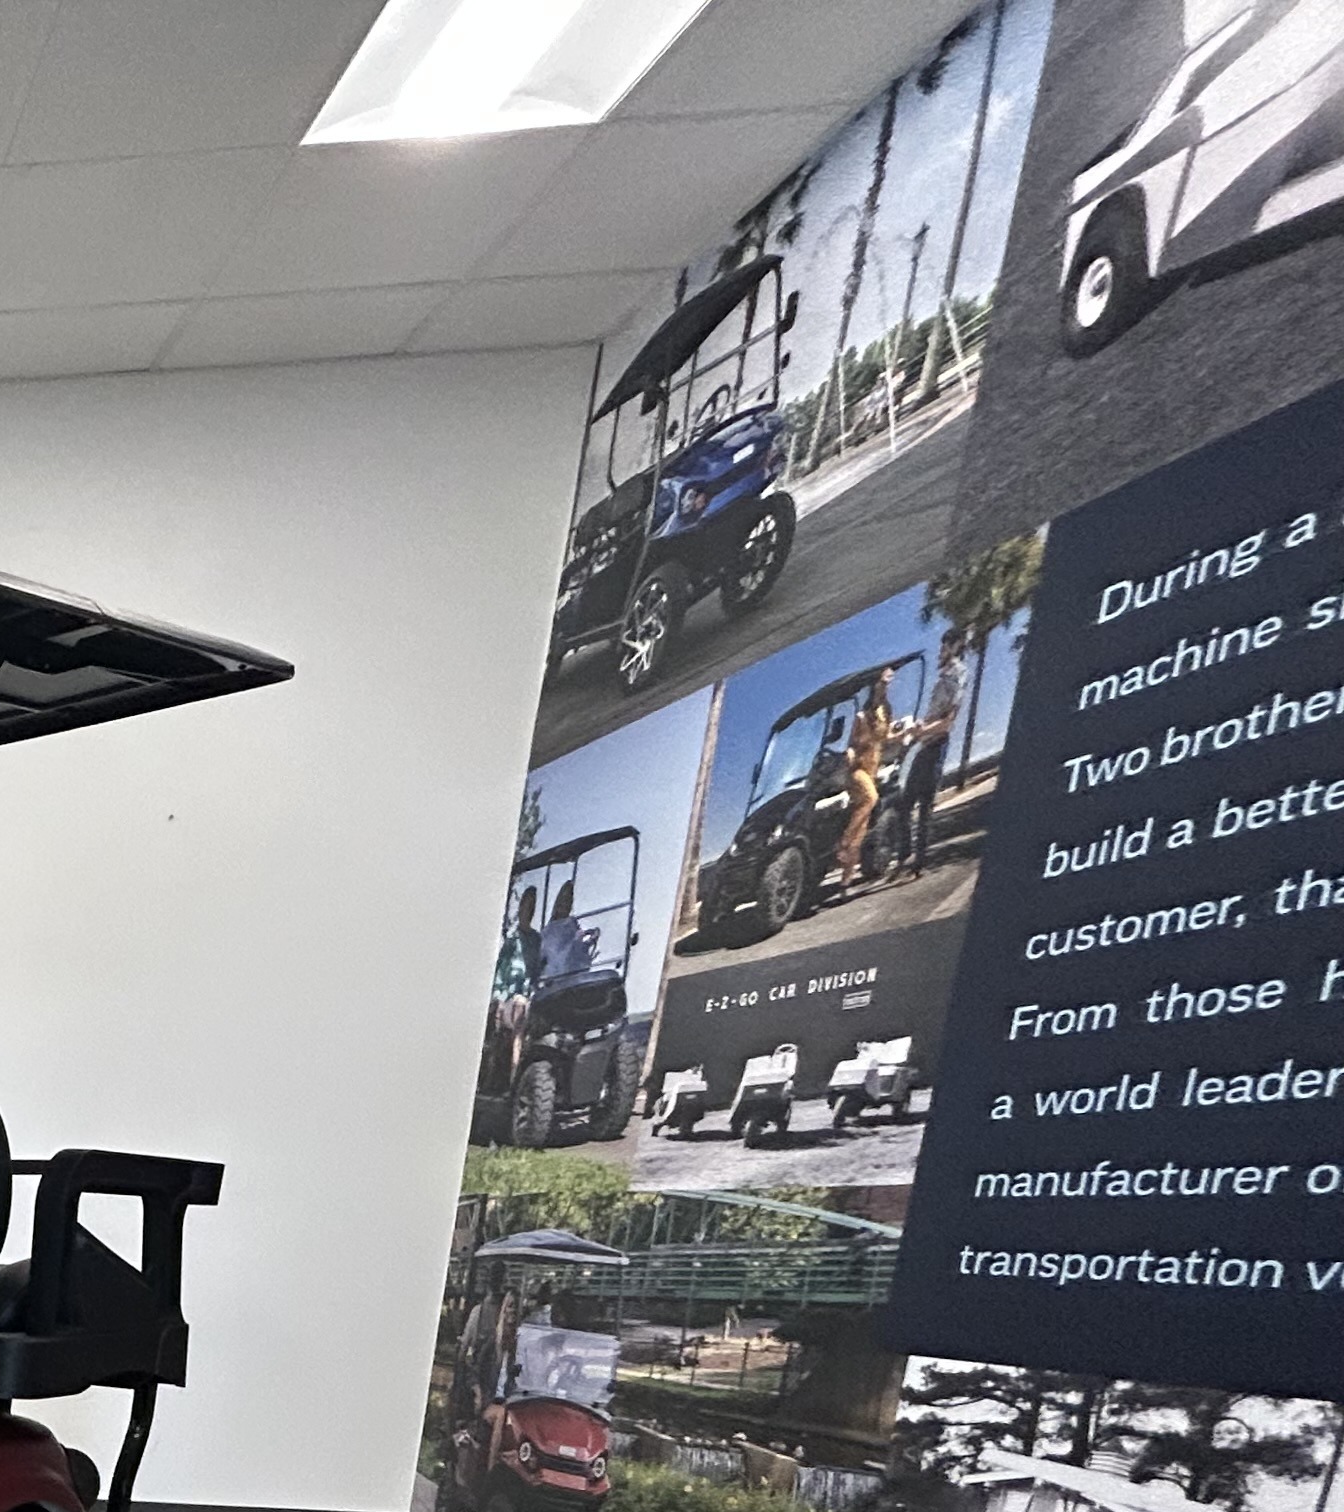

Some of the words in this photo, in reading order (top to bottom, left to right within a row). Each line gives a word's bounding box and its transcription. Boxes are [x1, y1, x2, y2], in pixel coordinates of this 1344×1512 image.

[1097, 528, 1267, 625] During
[1282, 512, 1317, 549] a
[1078, 616, 1283, 711] machine
[1063, 746, 1150, 793] Two
[1043, 816, 1154, 879] build
[1166, 818, 1196, 849] a
[1025, 894, 1248, 960] customer,
[705, 991, 759, 1012] E-Z-GO
[768, 983, 796, 1001] CAR
[807, 967, 878, 994] DIVISION
[1008, 1002, 1118, 1041] From
[1145, 979, 1286, 1024] those
[990, 1094, 1013, 1120] a
[1034, 1071, 1161, 1116] world
[1181, 1059, 1344, 1108] leader
[974, 1160, 1291, 1197] manufacturer
[959, 1245, 1285, 1288] transportation
